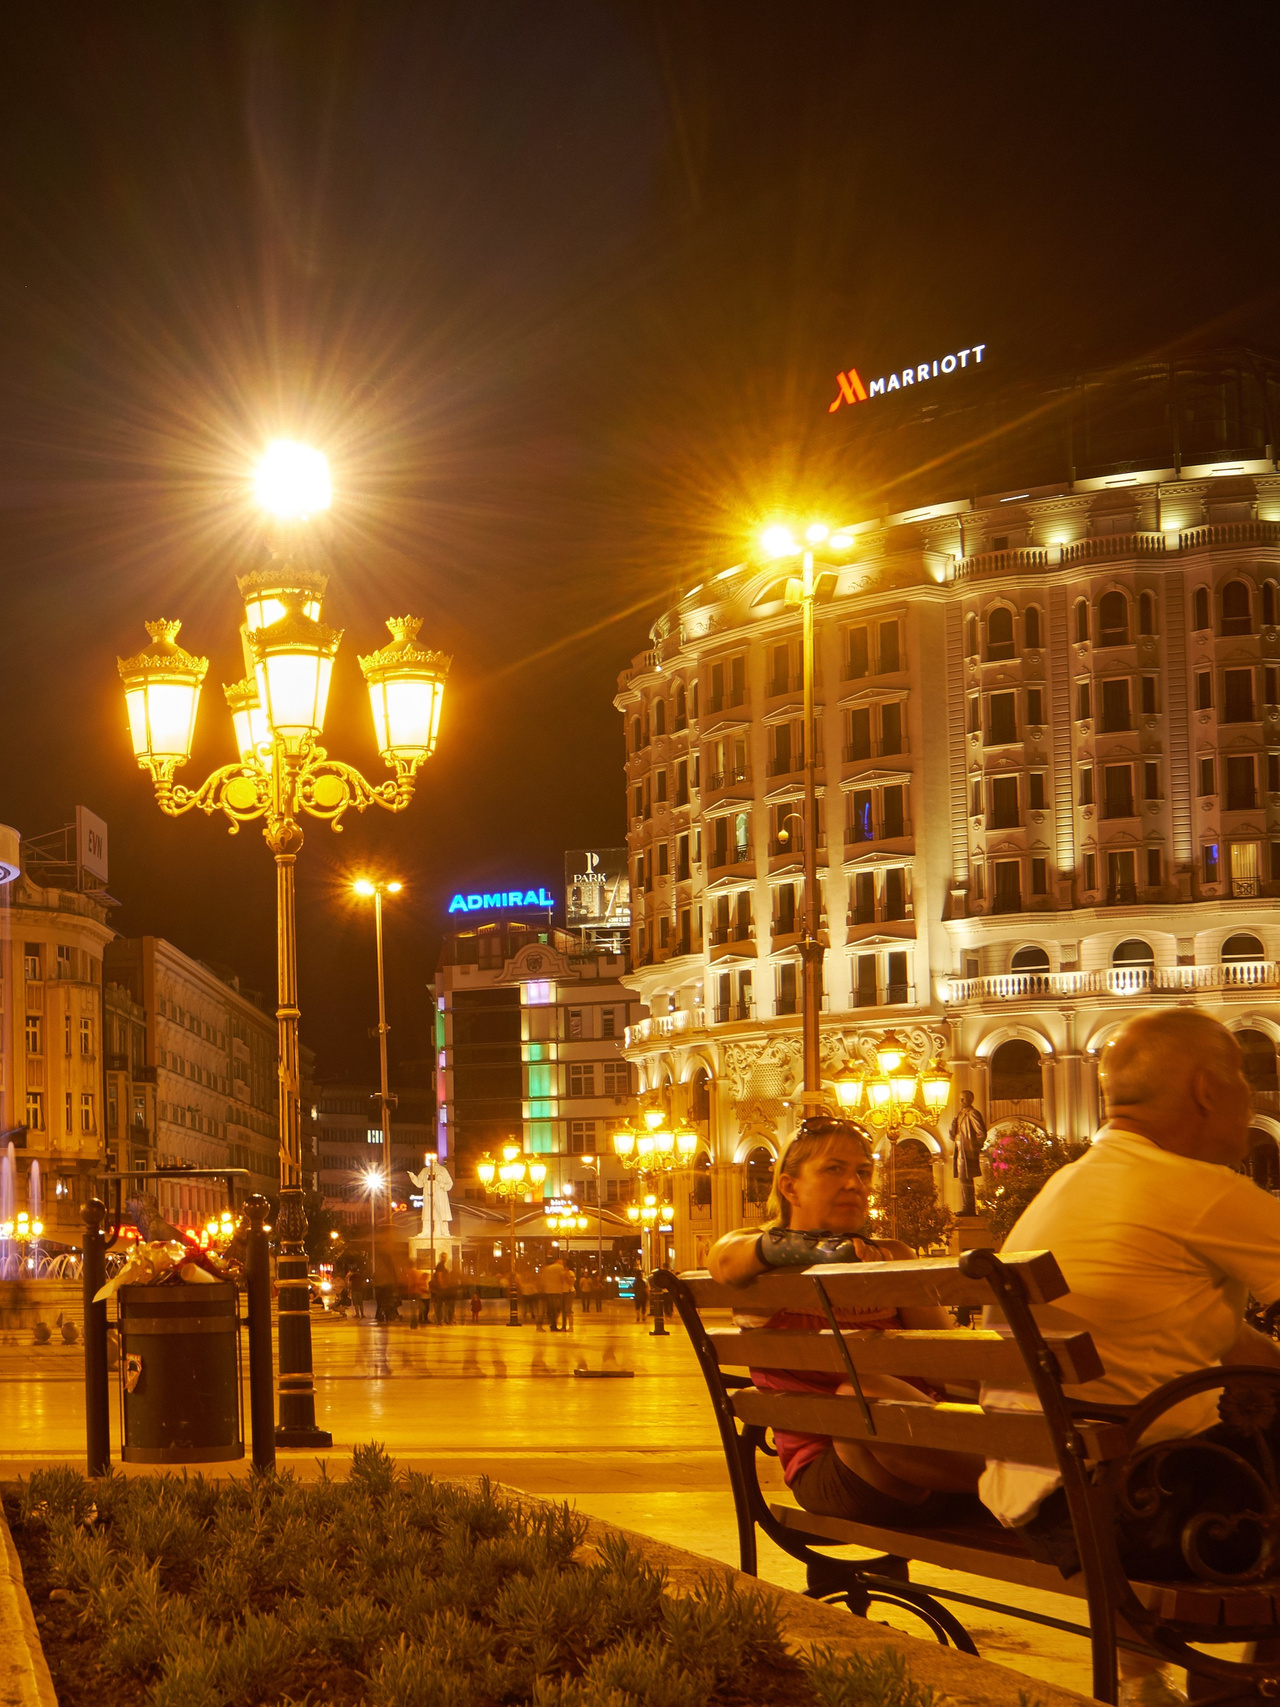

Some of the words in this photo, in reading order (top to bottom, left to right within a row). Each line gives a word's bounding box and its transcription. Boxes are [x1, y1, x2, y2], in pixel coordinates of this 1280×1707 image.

[869, 344, 986, 398] MARRIOTT
[88, 829, 103, 860] EVN
[573, 873, 607, 883] PARK
[448, 888, 554, 914] ADMIRAL
